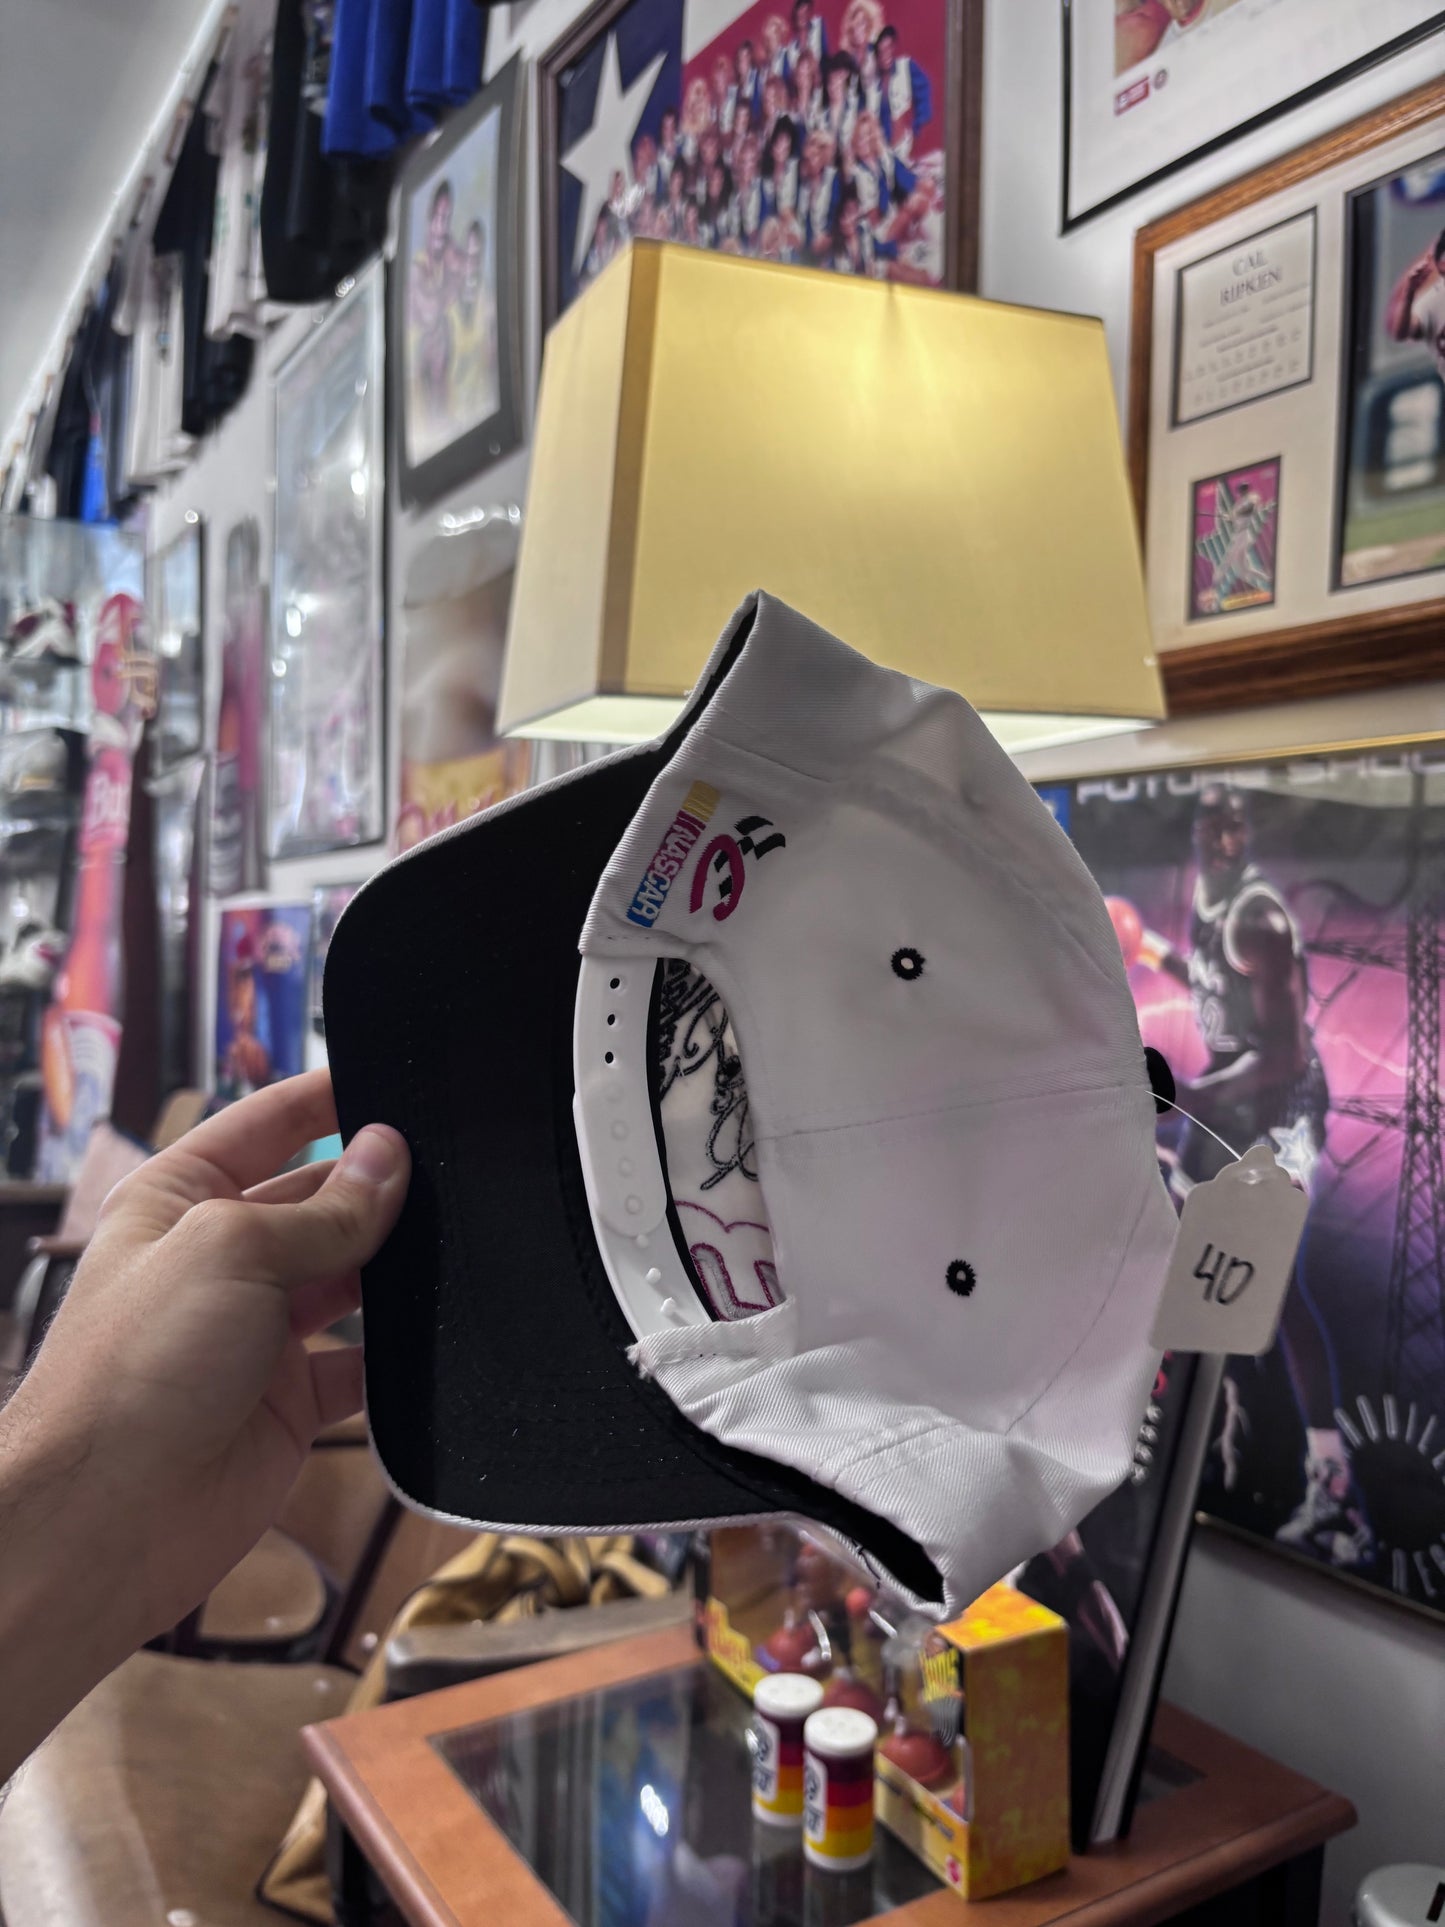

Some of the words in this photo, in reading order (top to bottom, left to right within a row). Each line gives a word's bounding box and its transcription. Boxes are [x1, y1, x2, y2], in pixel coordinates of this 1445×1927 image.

[1220, 266, 1283, 306] RIPKEN
[1232, 250, 1268, 276] CAL
[631, 823, 699, 921] NASCAR
[1193, 1243, 1255, 1305] 40
